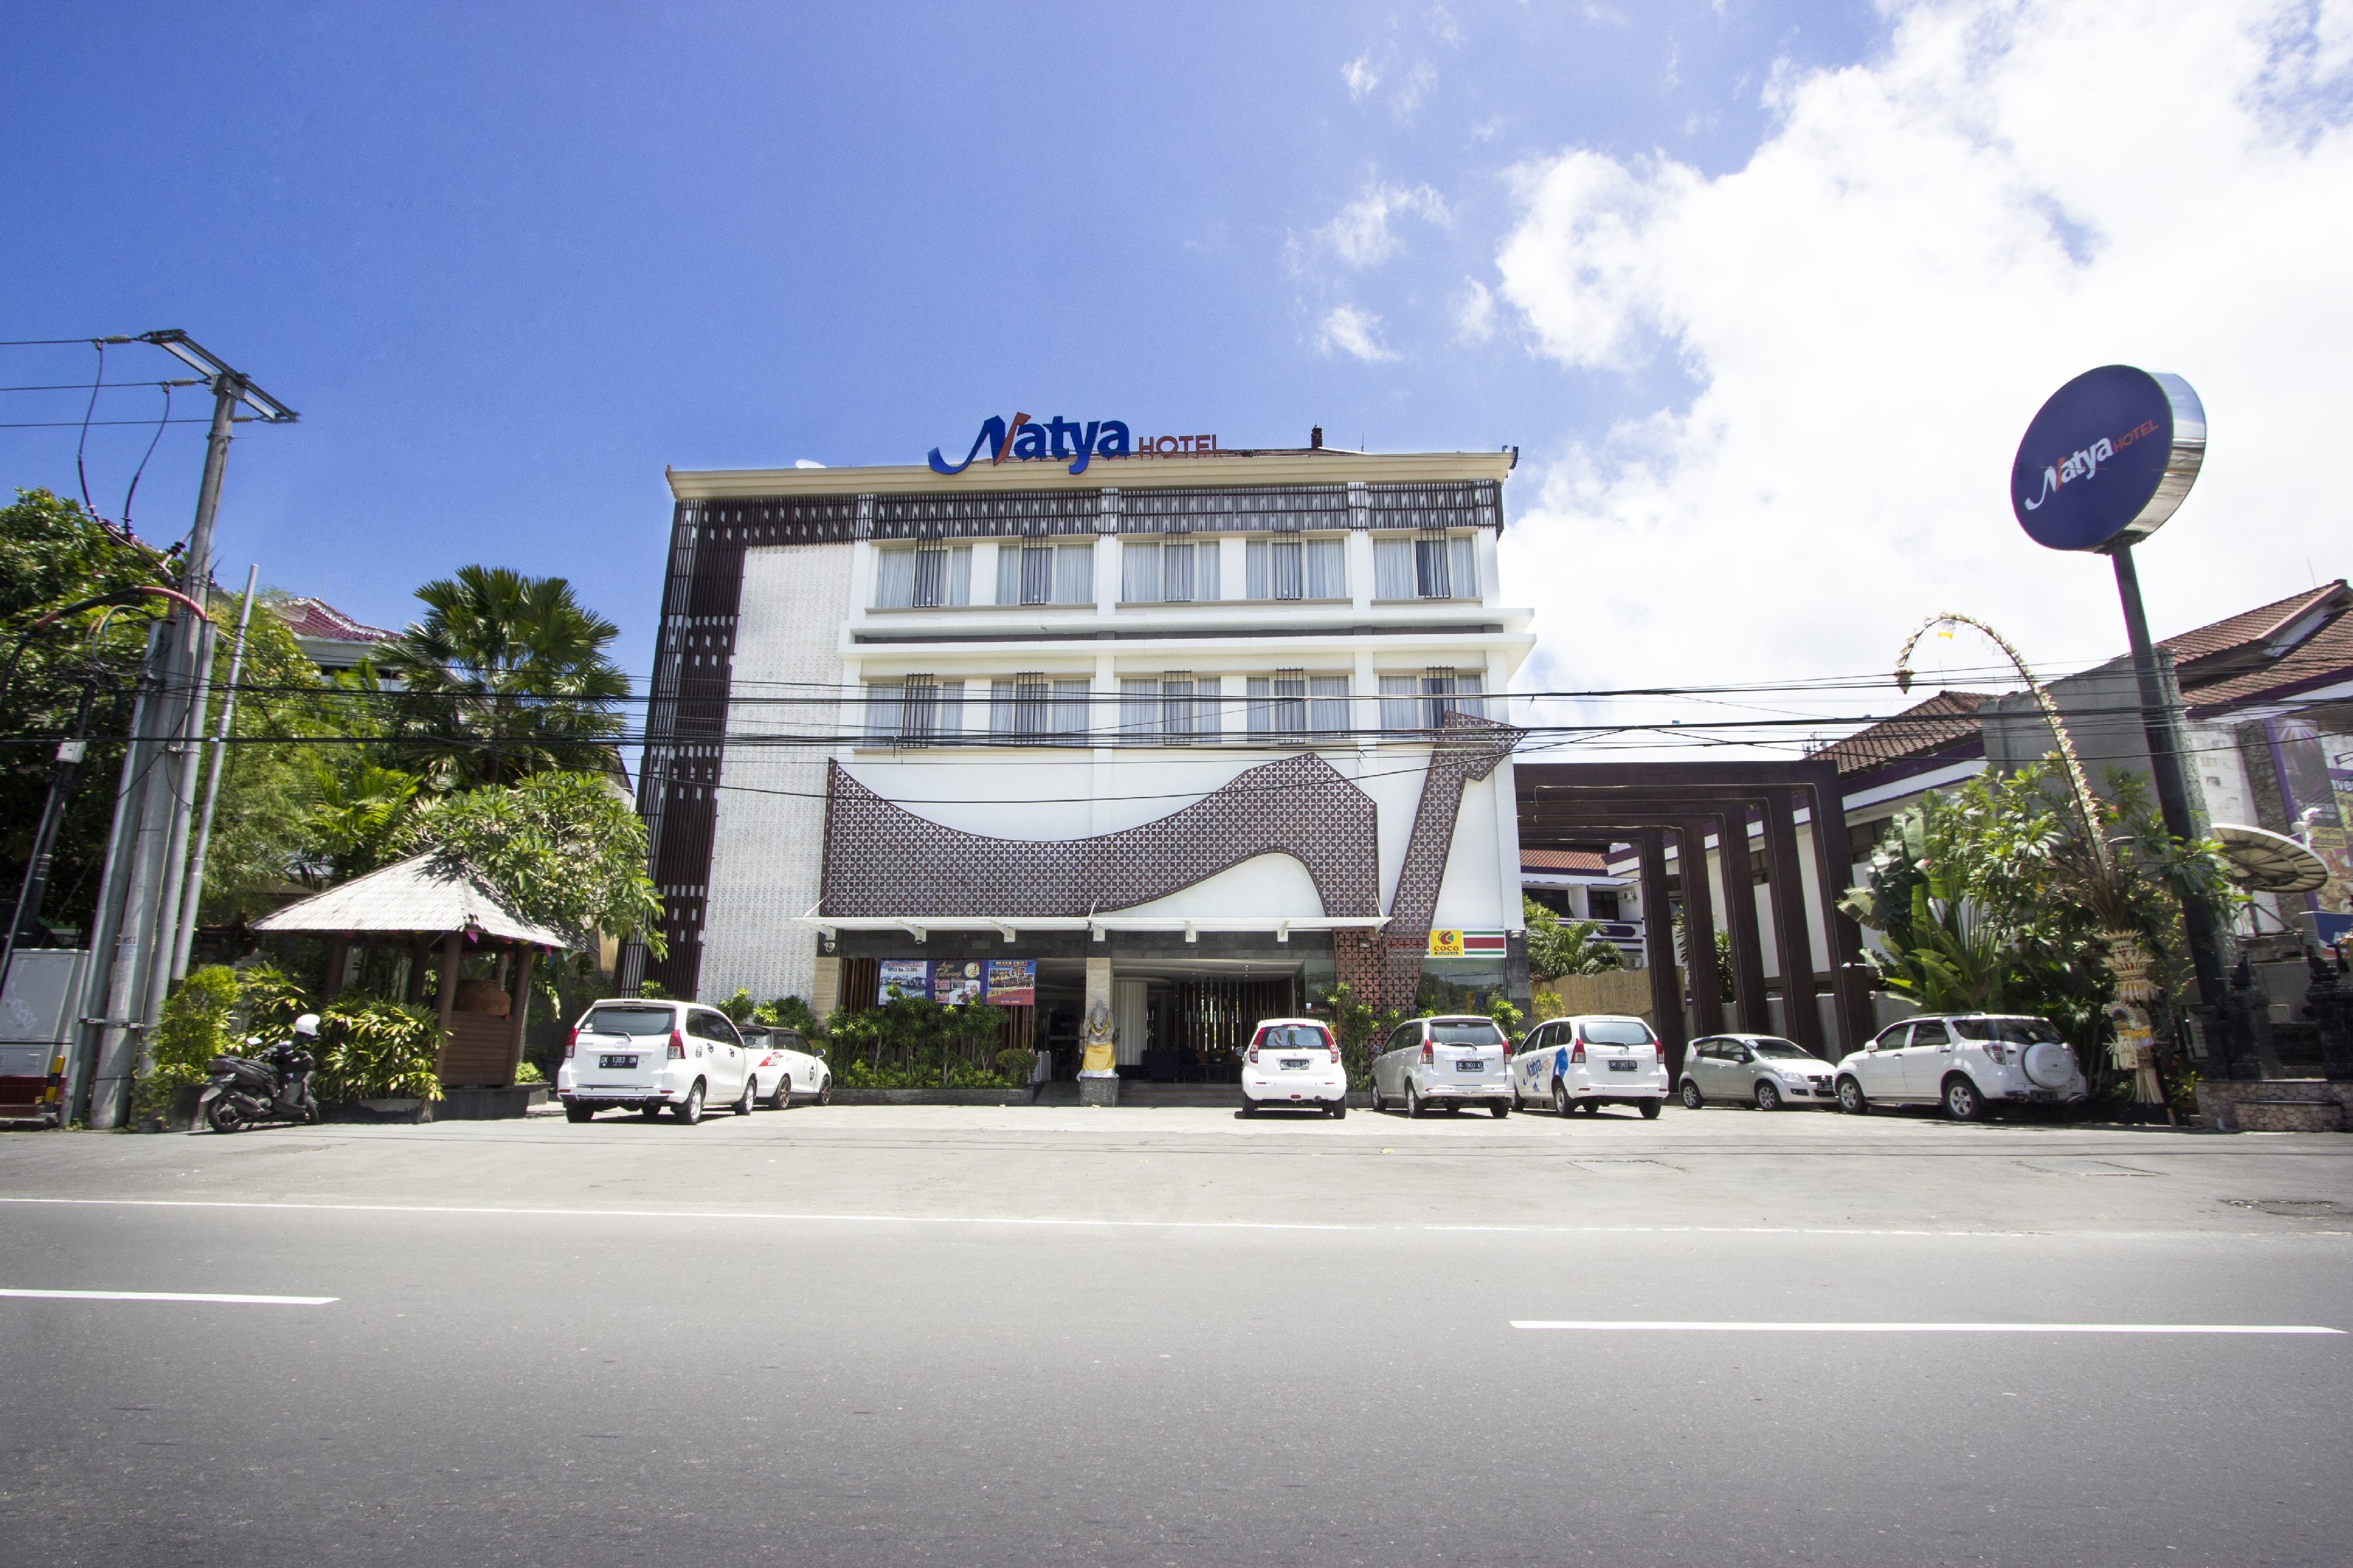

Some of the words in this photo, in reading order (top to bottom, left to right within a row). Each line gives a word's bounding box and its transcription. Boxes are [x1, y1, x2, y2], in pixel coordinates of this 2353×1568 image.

[928, 411, 1130, 475] Natya
[1138, 434, 1228, 455] HOTEL
[2025, 437, 2114, 510] Natya
[2113, 419, 2160, 454] HOTEL
[1523, 1058, 1543, 1085] Natya
